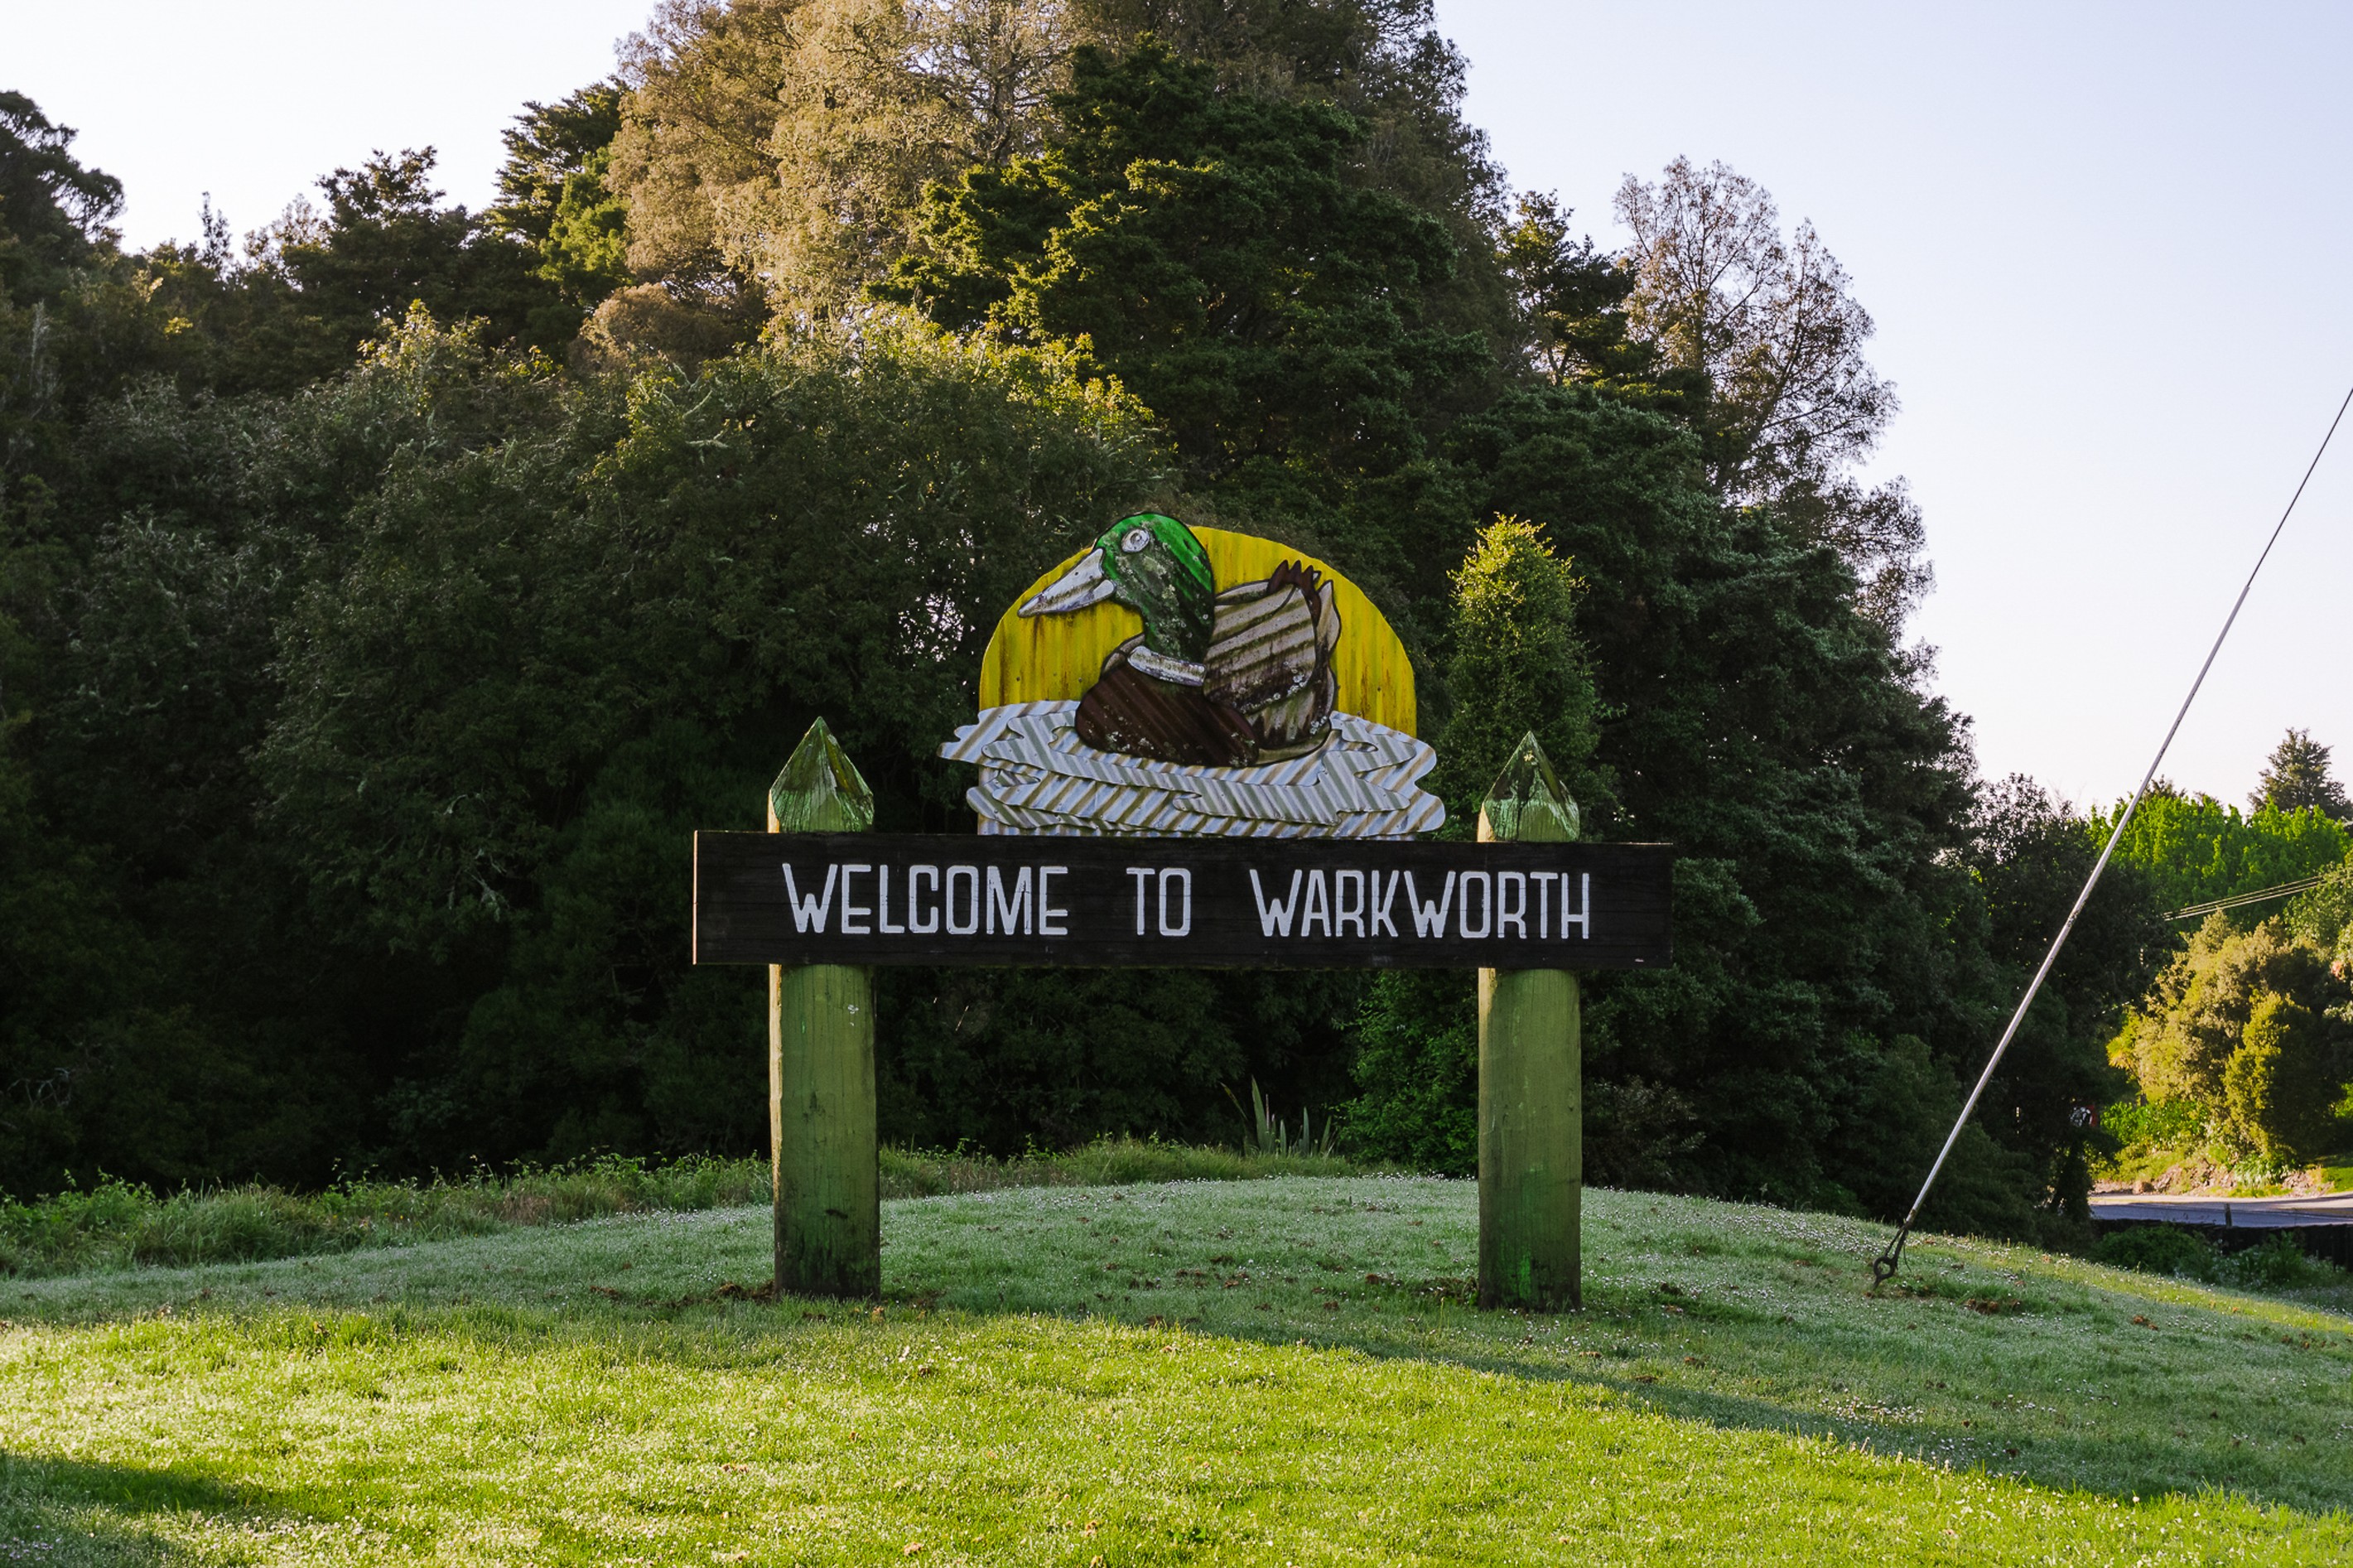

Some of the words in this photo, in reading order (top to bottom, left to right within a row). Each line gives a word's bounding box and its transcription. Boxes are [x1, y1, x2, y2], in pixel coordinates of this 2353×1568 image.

[782, 862, 1068, 935] WELCOME
[1126, 866, 1191, 936] TO
[1249, 869, 1590, 939] WARKWORTH
